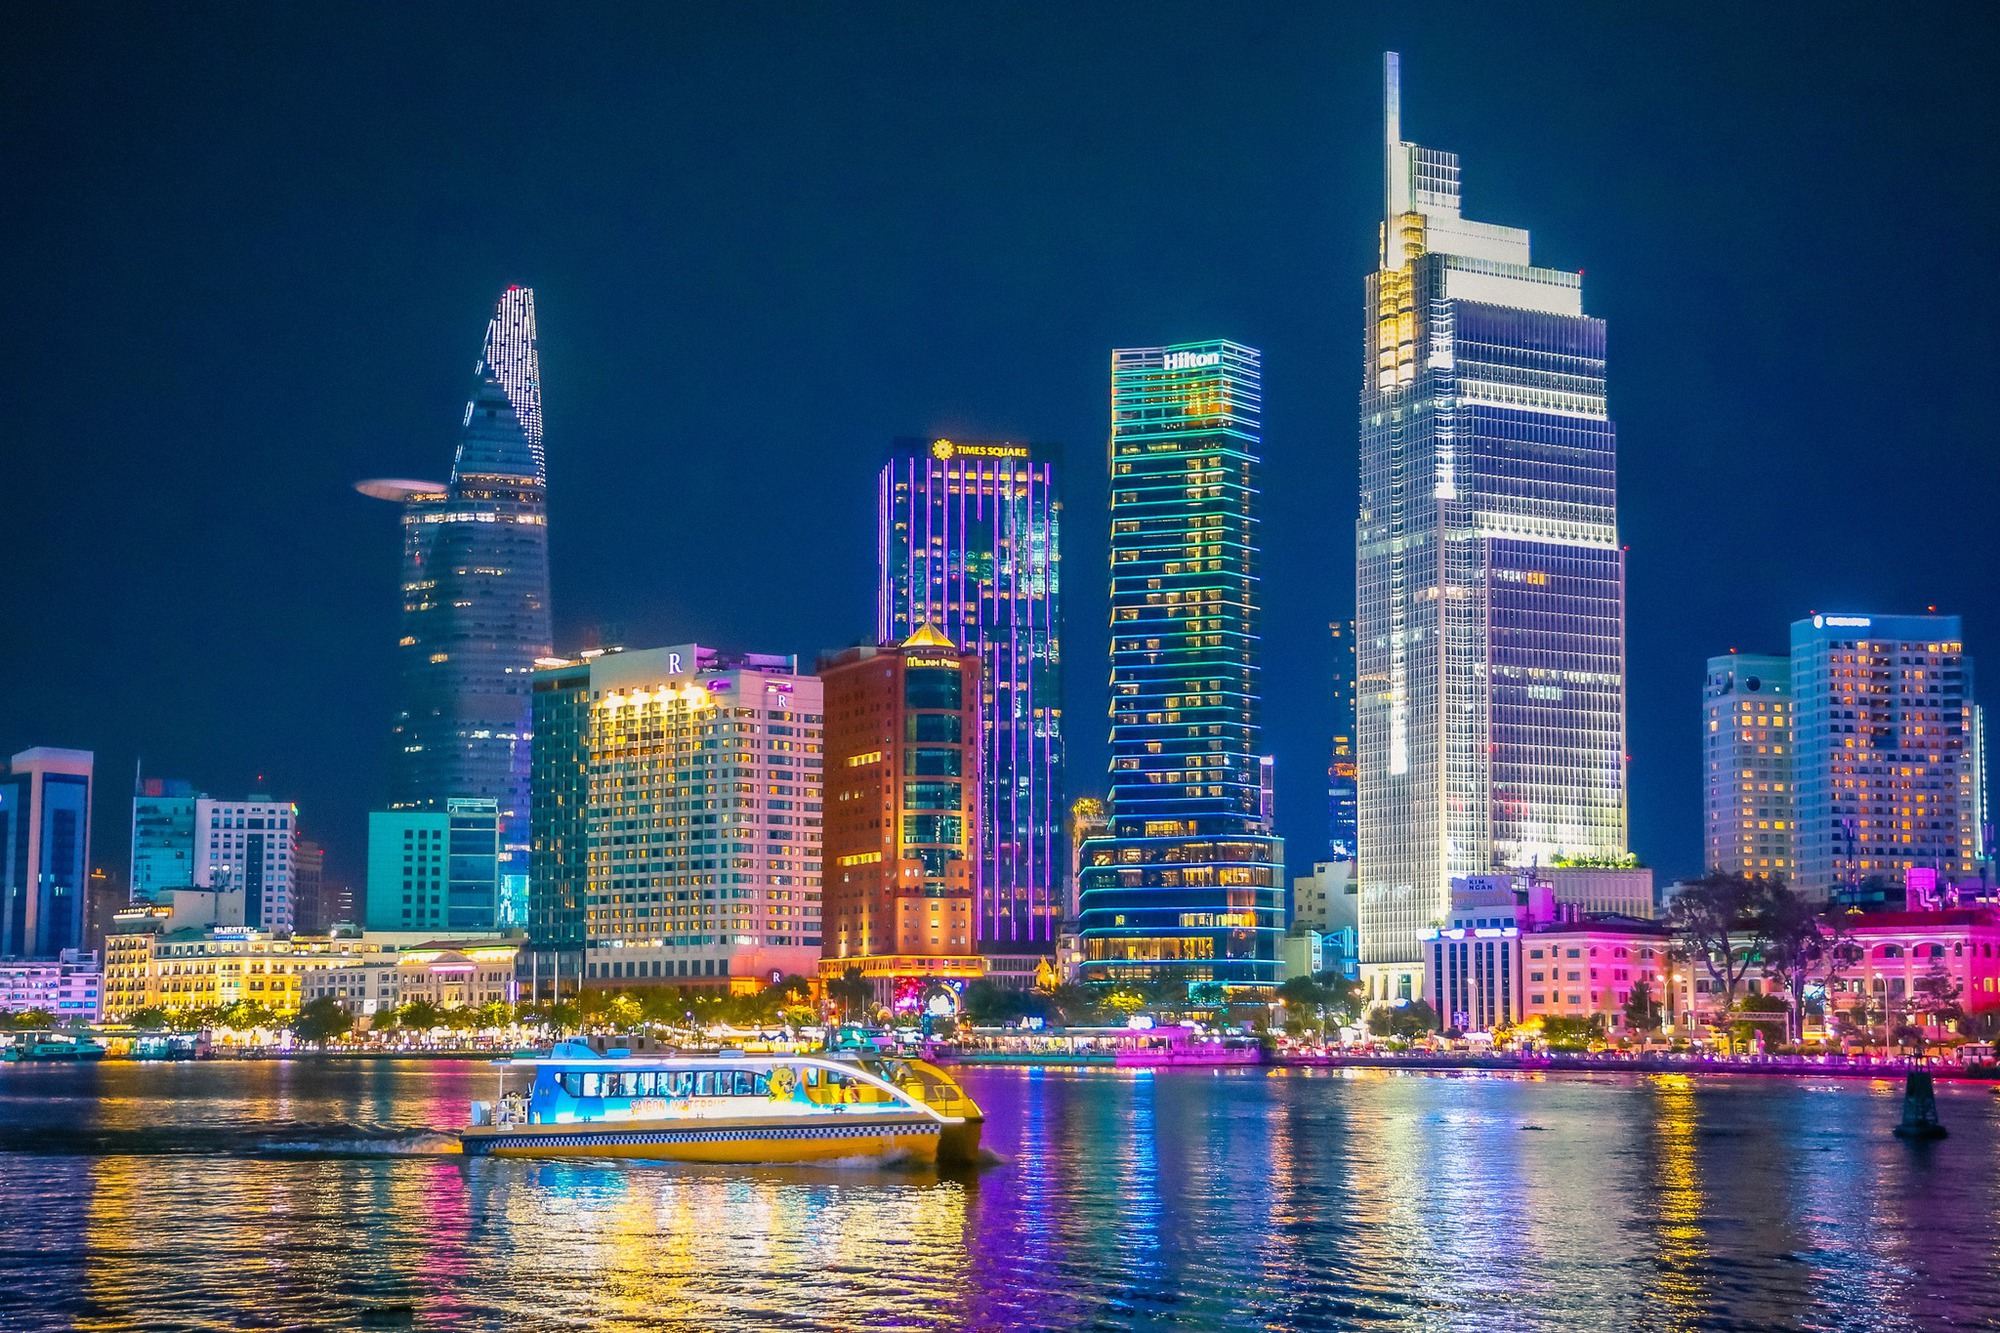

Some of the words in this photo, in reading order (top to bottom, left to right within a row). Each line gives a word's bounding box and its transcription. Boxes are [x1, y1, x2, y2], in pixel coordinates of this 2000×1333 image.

[1163, 351, 1219, 371] Hilton
[956, 445, 986, 456] TIMES
[987, 446, 1028, 458] SQUARE
[668, 653, 684, 675] R
[777, 694, 787, 708] R
[773, 971, 781, 983] R
[631, 1100, 666, 1113] SAIGON
